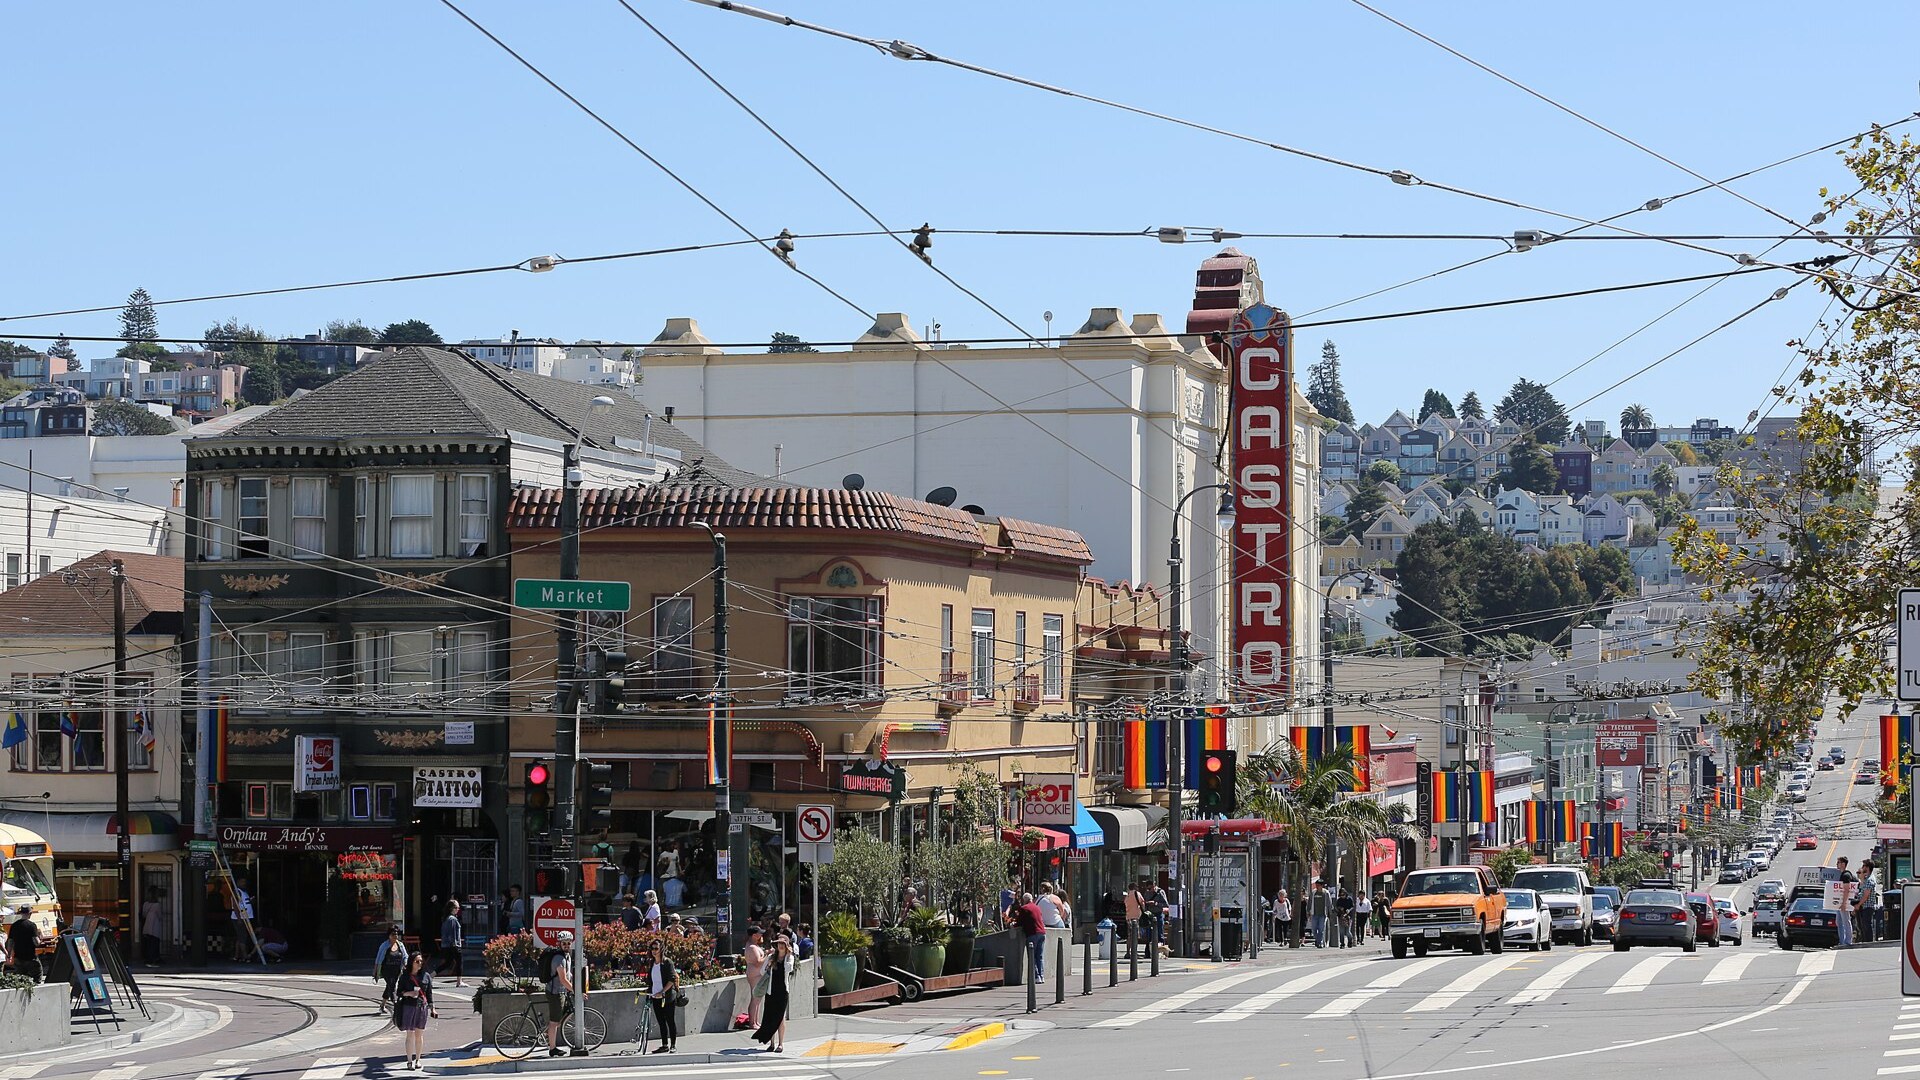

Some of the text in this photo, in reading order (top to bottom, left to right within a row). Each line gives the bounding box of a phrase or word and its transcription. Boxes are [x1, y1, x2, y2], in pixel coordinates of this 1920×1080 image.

[1241, 347, 1281, 685] CASTRO
[541, 587, 604, 604] Market
[305, 754, 313, 765] 24
[419, 769, 476, 778] CASTRO
[305, 774, 322, 789] Orphan
[426, 781, 480, 797] TATTOO
[1025, 785, 1071, 803] HOT
[1419, 763, 1429, 837] SLIDERS
[1026, 804, 1070, 815] COOKIE
[730, 824, 741, 832] ASTRO
[223, 826, 326, 844] Orphan Andy's
[1068, 847, 1087, 859] ATM
[1199, 857, 1232, 867] BUCKE UP
[1229, 867, 1241, 877] FOR
[1199, 877, 1208, 887] AN
[1225, 877, 1239, 887] RIDE
[1833, 882, 1856, 890] BLK
[541, 908, 574, 917] DO NOT
[544, 930, 560, 939] ENT
